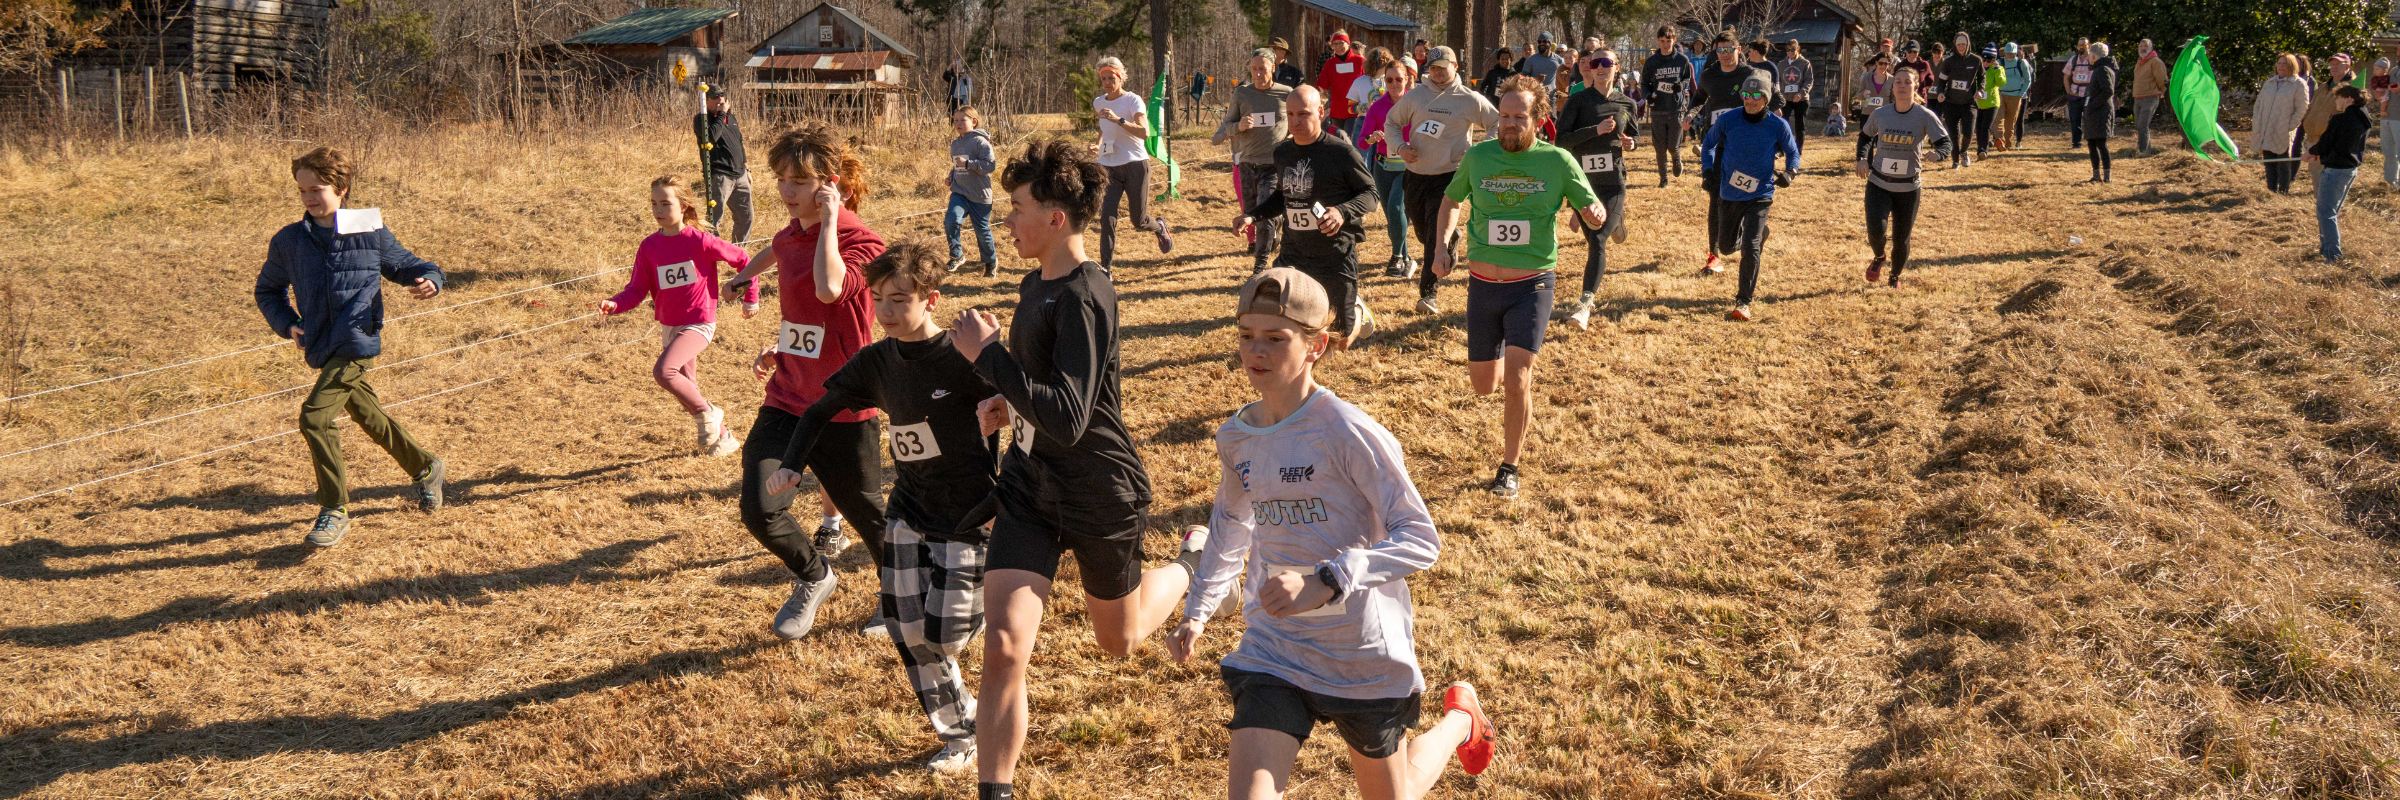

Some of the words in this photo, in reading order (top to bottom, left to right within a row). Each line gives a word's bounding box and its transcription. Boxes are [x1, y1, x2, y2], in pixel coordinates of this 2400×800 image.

[1260, 114, 1267, 125] 1
[1421, 121, 1439, 135] 15
[1589, 157, 1607, 170] 13
[1890, 162, 1898, 172] 4
[1484, 180, 1540, 191] SHAMROCK
[1735, 175, 1752, 189] 54
[1292, 213, 1310, 227] 45
[1497, 224, 1521, 242] 39
[665, 266, 689, 285] 64
[789, 328, 817, 353] 26
[895, 430, 925, 457] 63
[1279, 466, 1306, 476] FLEET
[1281, 474, 1304, 483] FEET
